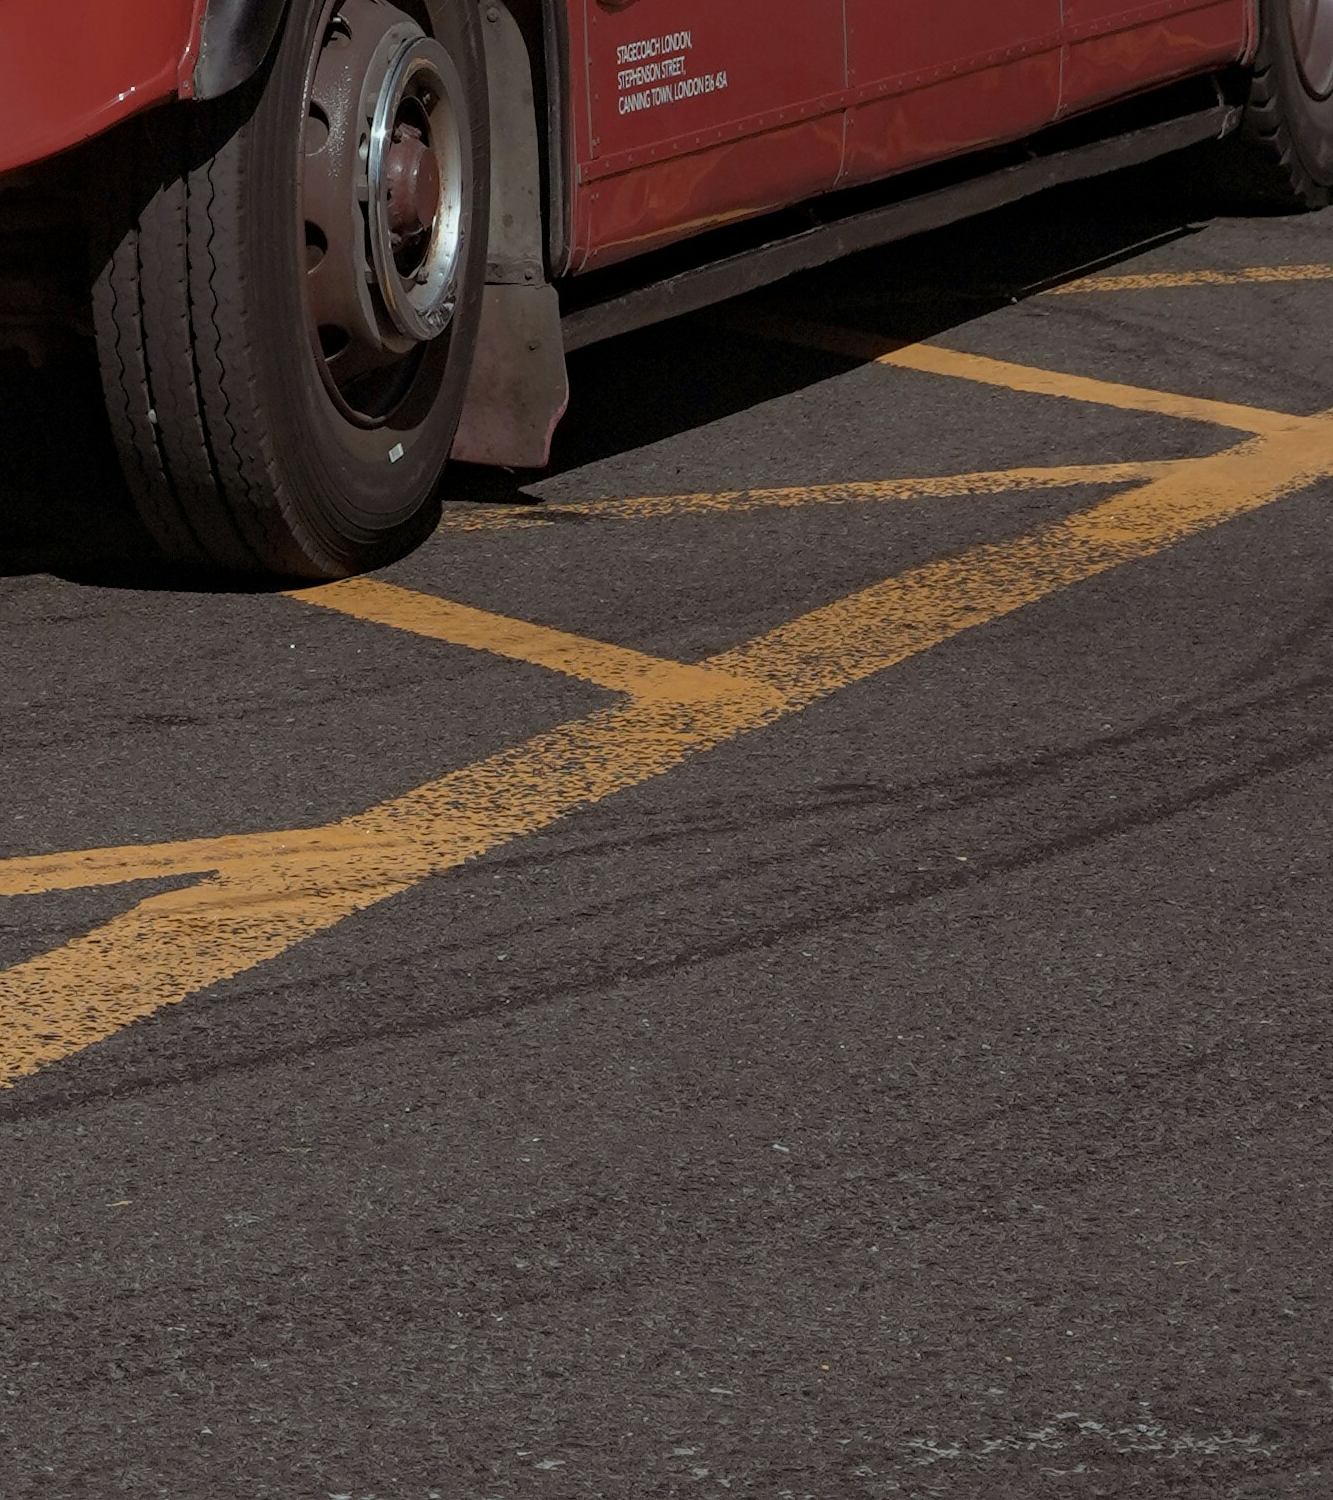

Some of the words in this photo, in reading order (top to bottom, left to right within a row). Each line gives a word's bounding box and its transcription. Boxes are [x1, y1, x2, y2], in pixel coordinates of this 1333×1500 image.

[616, 36, 661, 65] STAGECOACH
[661, 29, 693, 55] LONDON,
[617, 61, 661, 90] STEPHENSON
[618, 89, 651, 115] CANNING
[651, 84, 674, 106] TOWN,
[674, 76, 705, 100] LONDON
